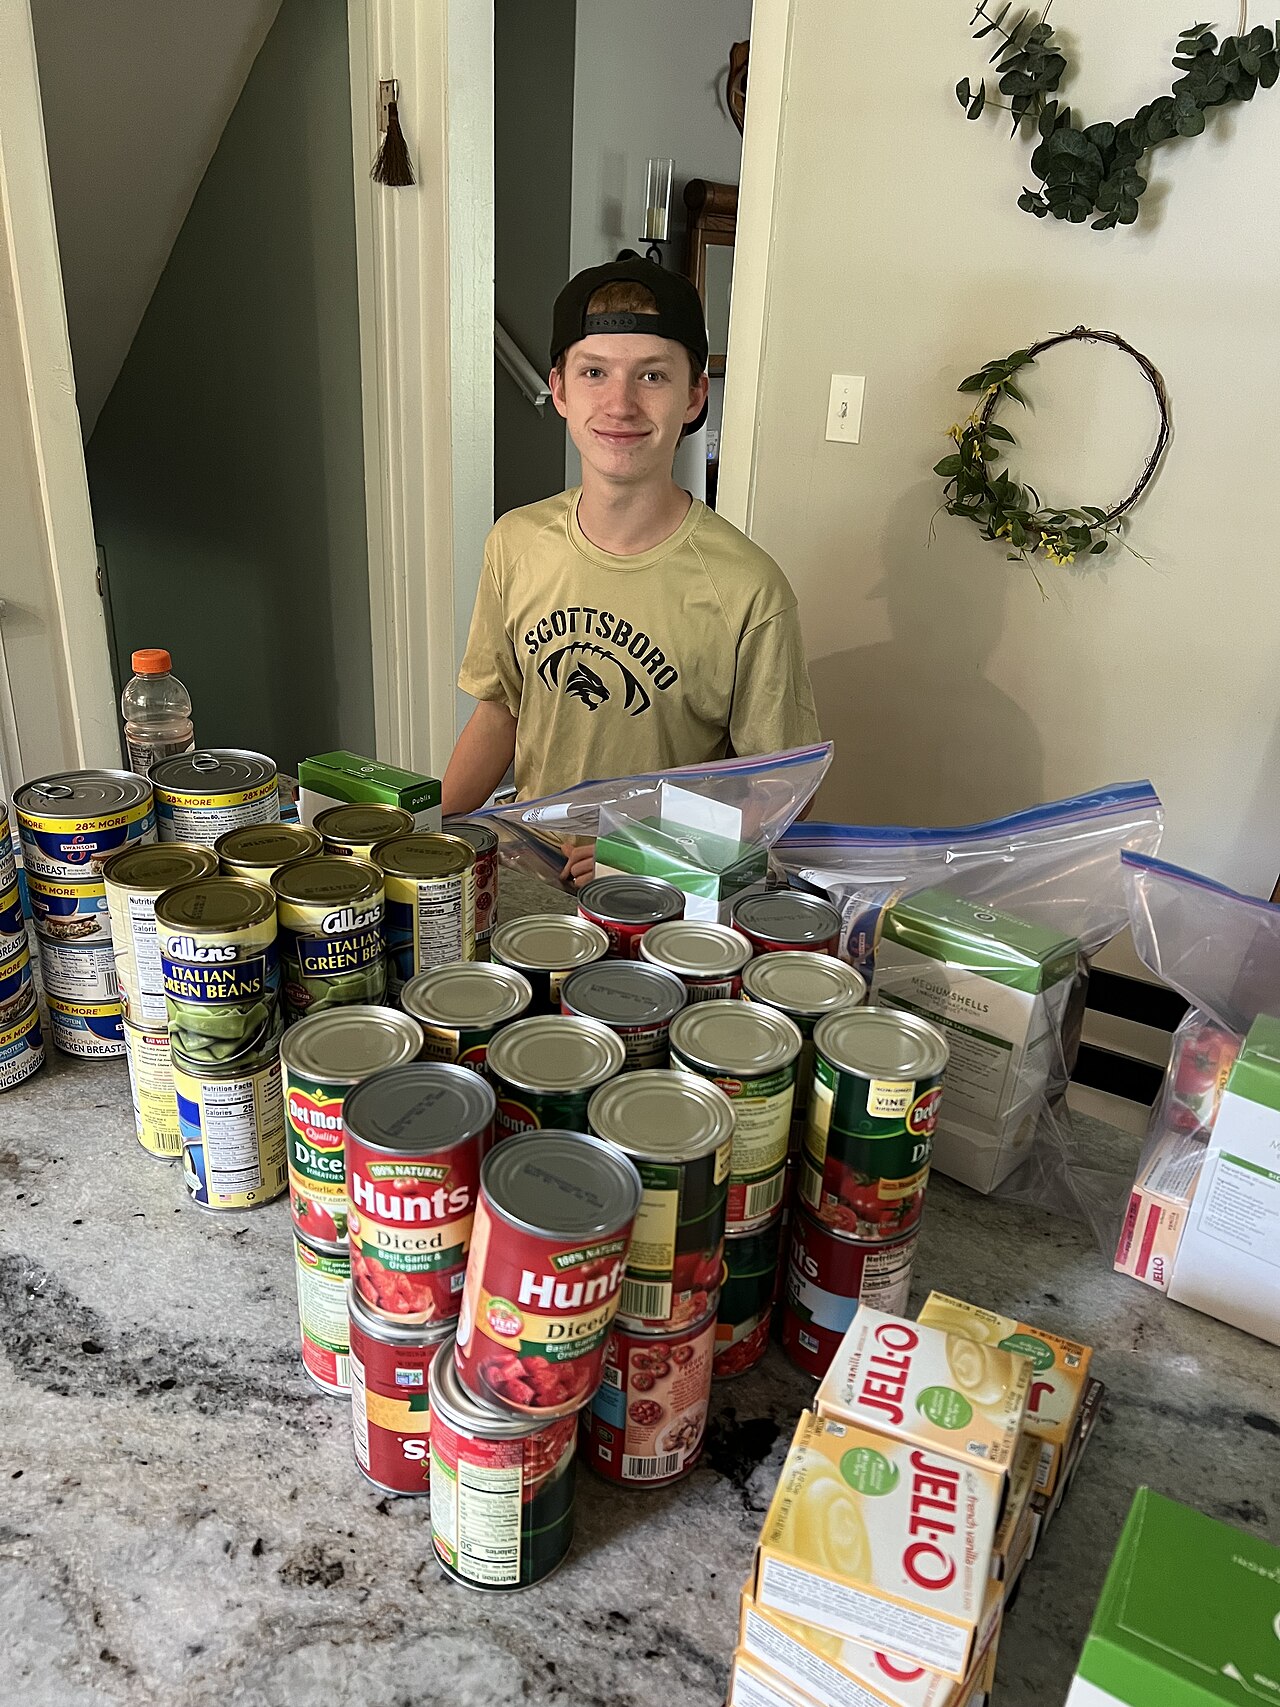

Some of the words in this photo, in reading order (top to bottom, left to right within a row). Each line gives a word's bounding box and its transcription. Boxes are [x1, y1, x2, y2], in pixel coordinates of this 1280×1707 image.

[524, 606, 679, 692] SCOTTSBORO
[166, 795, 182, 804] 28%
[242, 791, 259, 802] 28%
[75, 821, 96, 831] 28%
[62, 844, 96, 852] SWANSON
[37, 863, 67, 877] BREAST
[327, 930, 380, 955] ITALIAN
[304, 954, 358, 972] GREEN
[362, 939, 387, 962] BEAN
[172, 966, 236, 983] ITALIAN
[206, 978, 260, 999] BEANS
[911, 976, 951, 998] MEDIUM
[950, 991, 989, 1013] SHELLS
[0, 1033, 12, 1045] 8%
[87, 1044, 121, 1054] BREAST
[234, 1082, 252, 1091] Facts
[242, 1103, 254, 1113] 25
[876, 1098, 907, 1107] VINE
[290, 1098, 310, 1124] Del
[305, 1127, 340, 1145] Quality
[294, 1141, 346, 1174] Dice
[371, 1165, 396, 1177] 100%
[397, 1166, 444, 1179] NATURAL
[308, 1181, 334, 1195] Garlic
[376, 1230, 443, 1250] Diced
[377, 1251, 405, 1262] Basil,
[405, 1253, 432, 1263] Garlic
[434, 1252, 442, 1261] &
[557, 1253, 584, 1268] 100%
[389, 1262, 430, 1273] Oregano
[490, 1317, 519, 1330] STEAM
[547, 1307, 610, 1339] Diced
[546, 1343, 572, 1353] Basil,
[557, 1343, 595, 1360] Oregano
[847, 1351, 862, 1385] vanilla
[967, 1495, 979, 1527] french
[460, 1540, 472, 1553] 50
[485, 1548, 518, 1556] Calories
[964, 1526, 979, 1567] vanilla
[482, 1573, 517, 1583] Nutrition
